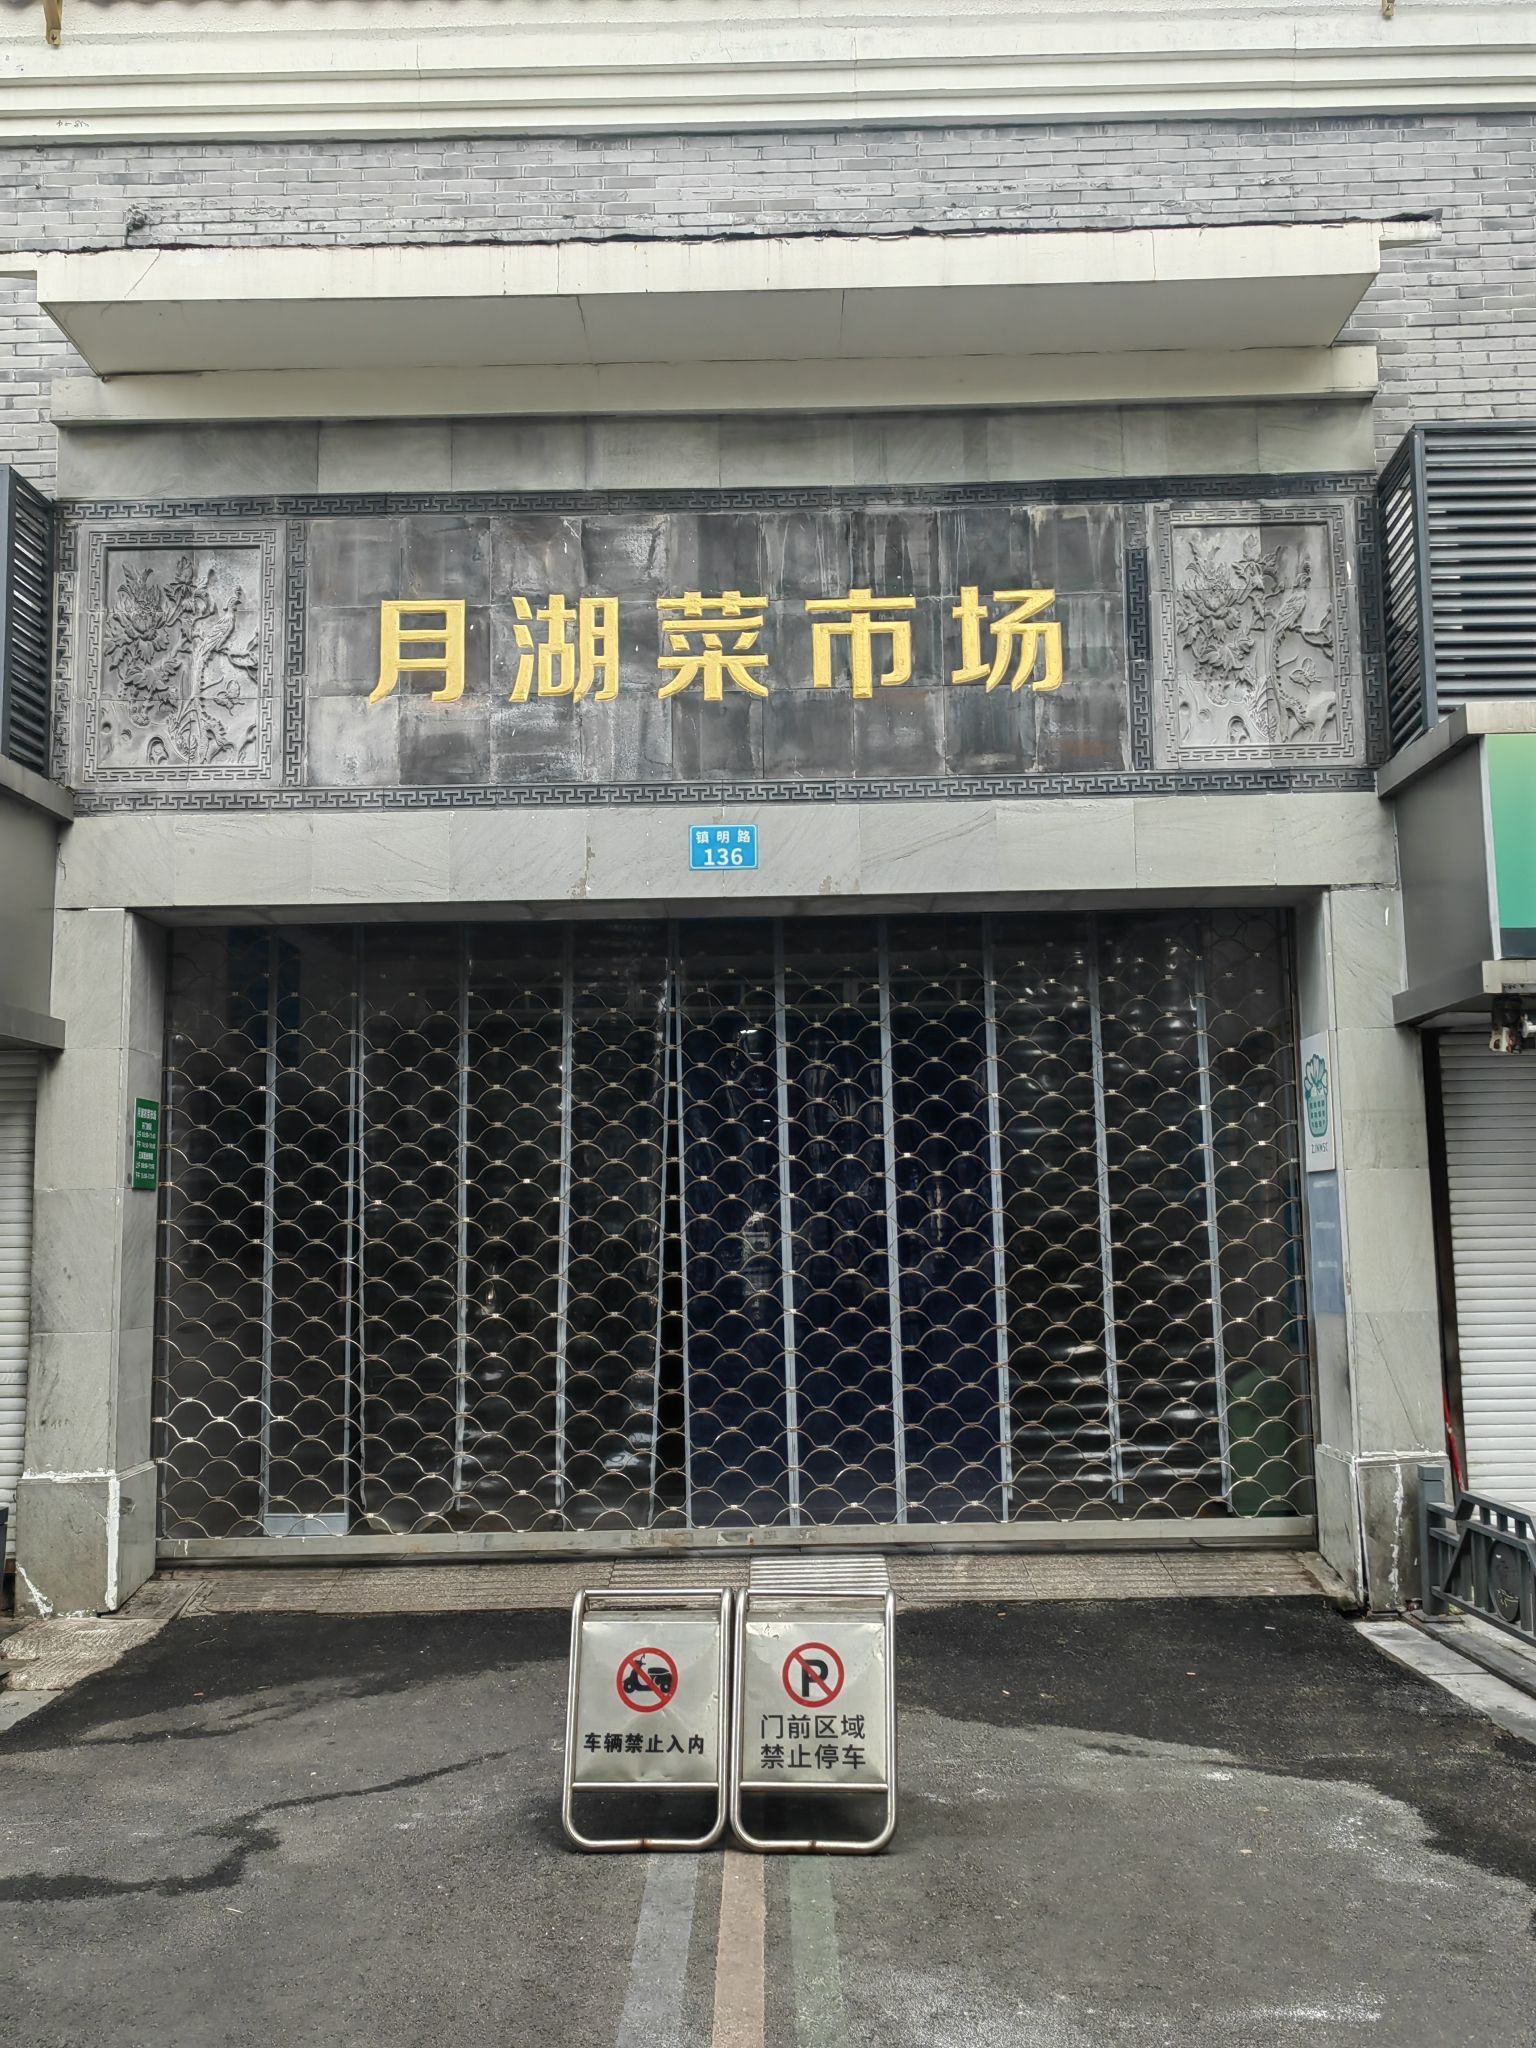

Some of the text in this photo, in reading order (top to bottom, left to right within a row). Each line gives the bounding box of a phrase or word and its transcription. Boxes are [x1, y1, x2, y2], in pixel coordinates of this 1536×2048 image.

[369, 585, 1063, 702] 月湖菜市场
[695, 829, 751, 844] 镇明路
[703, 847, 744, 866] 136
[760, 1714, 866, 1740] 门前区域
[583, 1732, 705, 1755] 车辆禁止入内
[760, 1743, 866, 1770] 禁止停车
